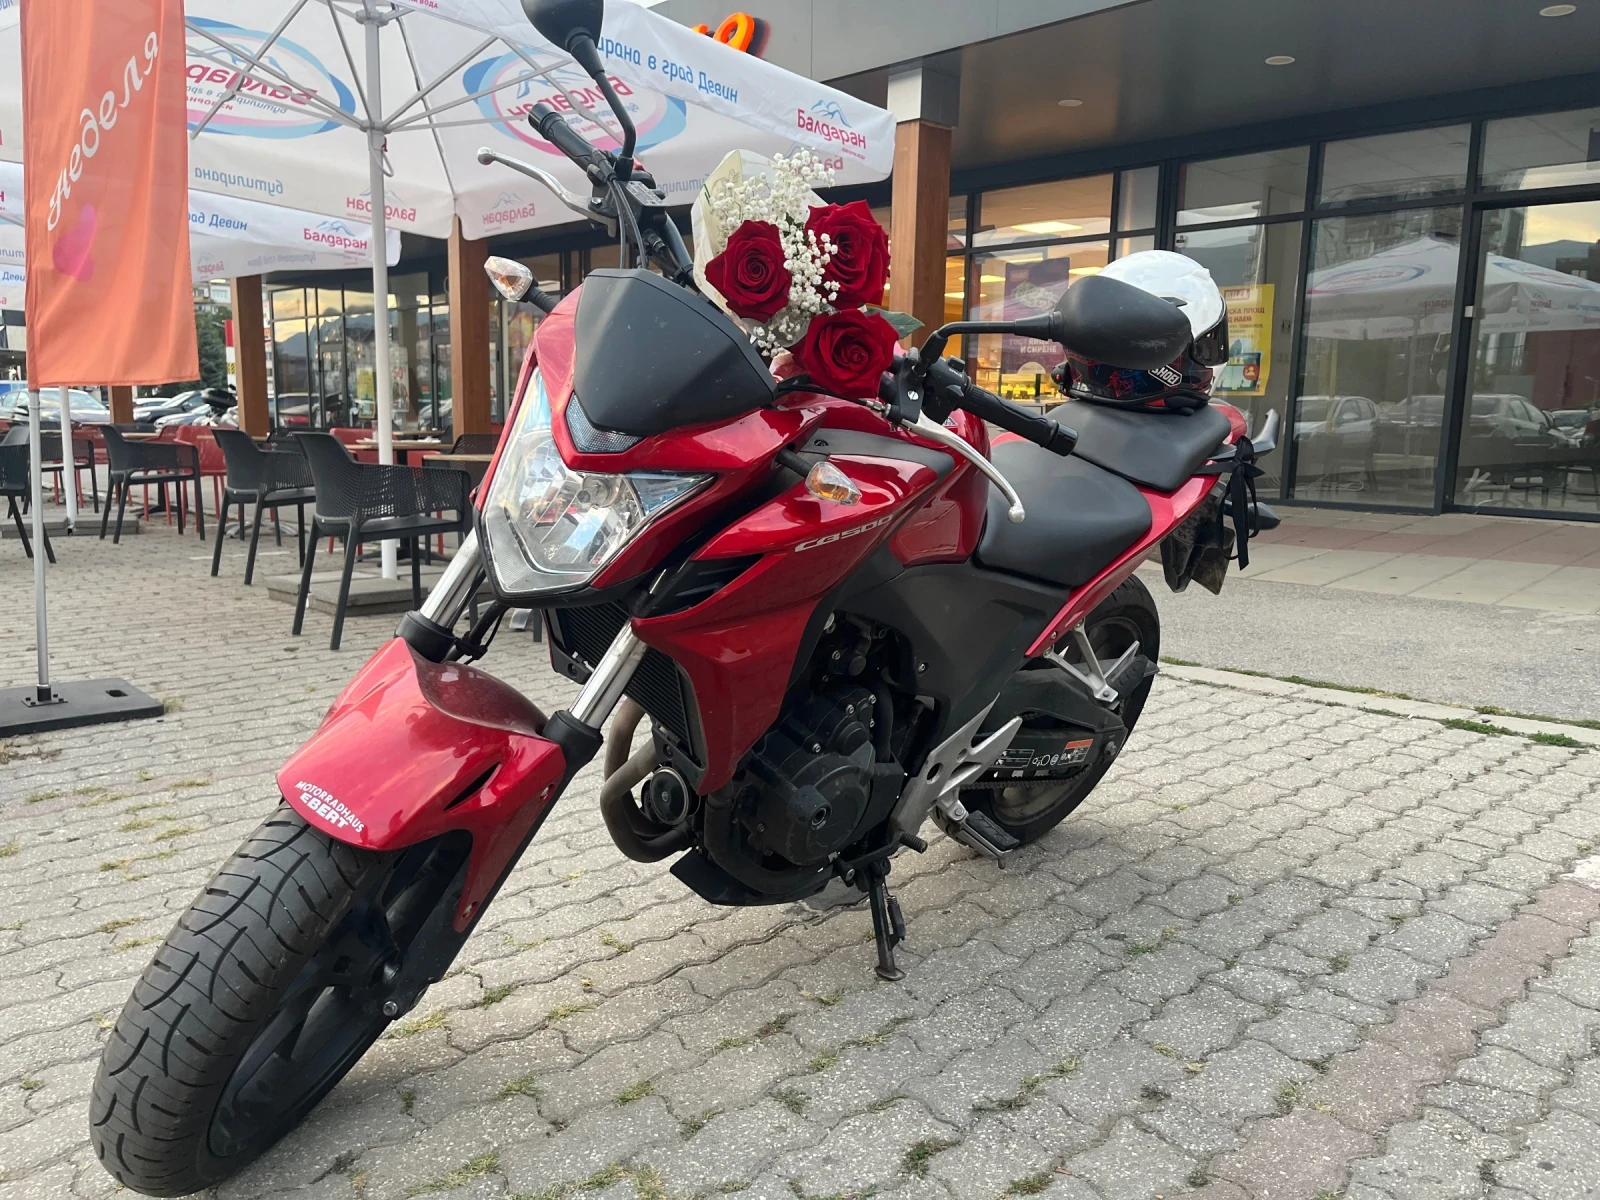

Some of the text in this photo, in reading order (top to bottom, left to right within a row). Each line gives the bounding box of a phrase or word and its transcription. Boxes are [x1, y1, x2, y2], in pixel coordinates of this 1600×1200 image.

[648, 55, 656, 70] в
[662, 60, 693, 82] град
[698, 71, 738, 103] Девин
[47, 31, 159, 231] неделя
[797, 108, 867, 149] Балдаран
[208, 213, 248, 232] Девин
[303, 228, 368, 251] Балдаран
[295, 781, 365, 833] MOTORRADHAUS
[300, 792, 349, 828] EBERT
